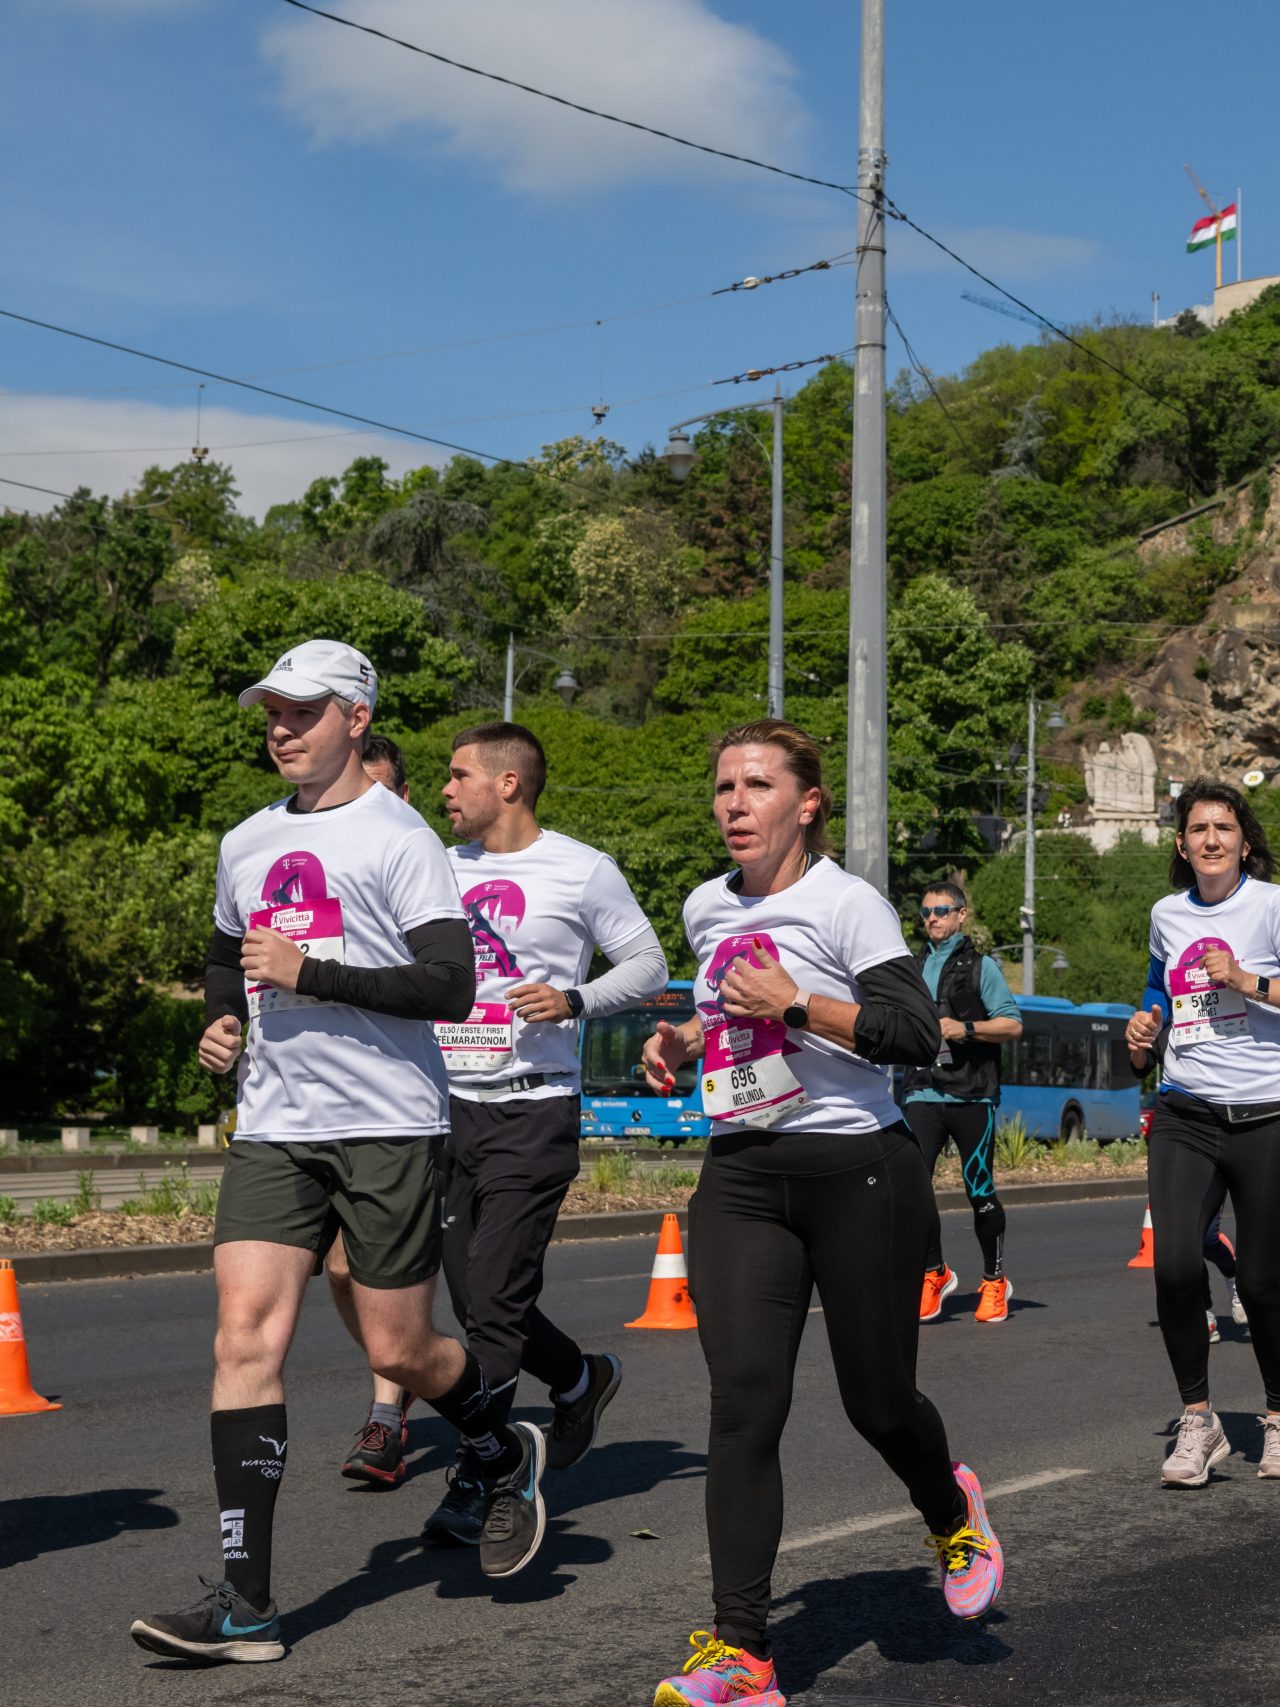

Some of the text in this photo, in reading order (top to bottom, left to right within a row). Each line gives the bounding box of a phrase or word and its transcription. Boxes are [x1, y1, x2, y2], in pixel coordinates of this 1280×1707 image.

[1175, 1000, 1182, 1009] 5
[1191, 992, 1219, 1008] 5123
[440, 1026, 456, 1034] ELSŐ
[486, 1027, 504, 1035] FIRST
[437, 1034, 507, 1046] FÉLMARATONOM
[731, 1066, 757, 1089] 696
[706, 1080, 714, 1092] 5
[732, 1087, 766, 1107] MELINDA
